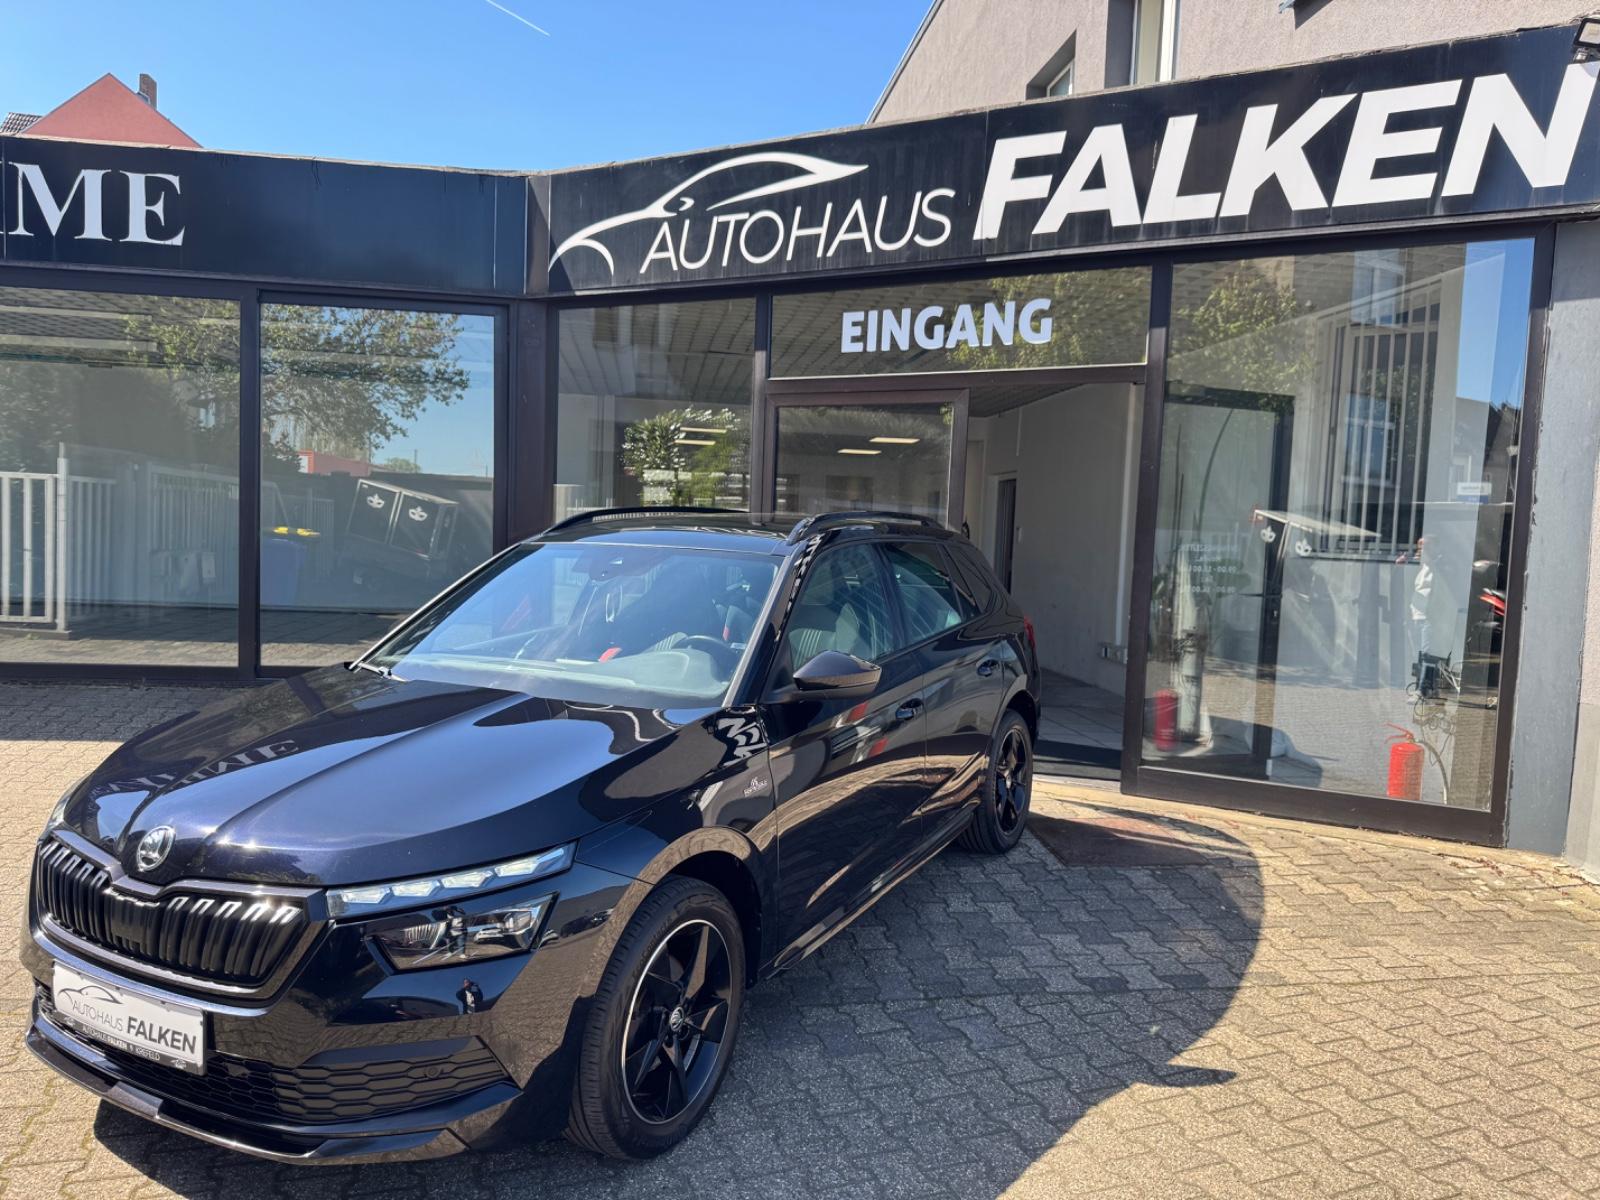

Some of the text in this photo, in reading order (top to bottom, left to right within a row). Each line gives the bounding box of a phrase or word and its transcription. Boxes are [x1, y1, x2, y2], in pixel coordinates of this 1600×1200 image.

[639, 61, 1600, 274] AUTOHAUS FALKEN
[0, 161, 186, 246] ME
[841, 298, 1053, 353] EINGANG
[72, 1000, 197, 1054] AUTOHAUS FALKEN
